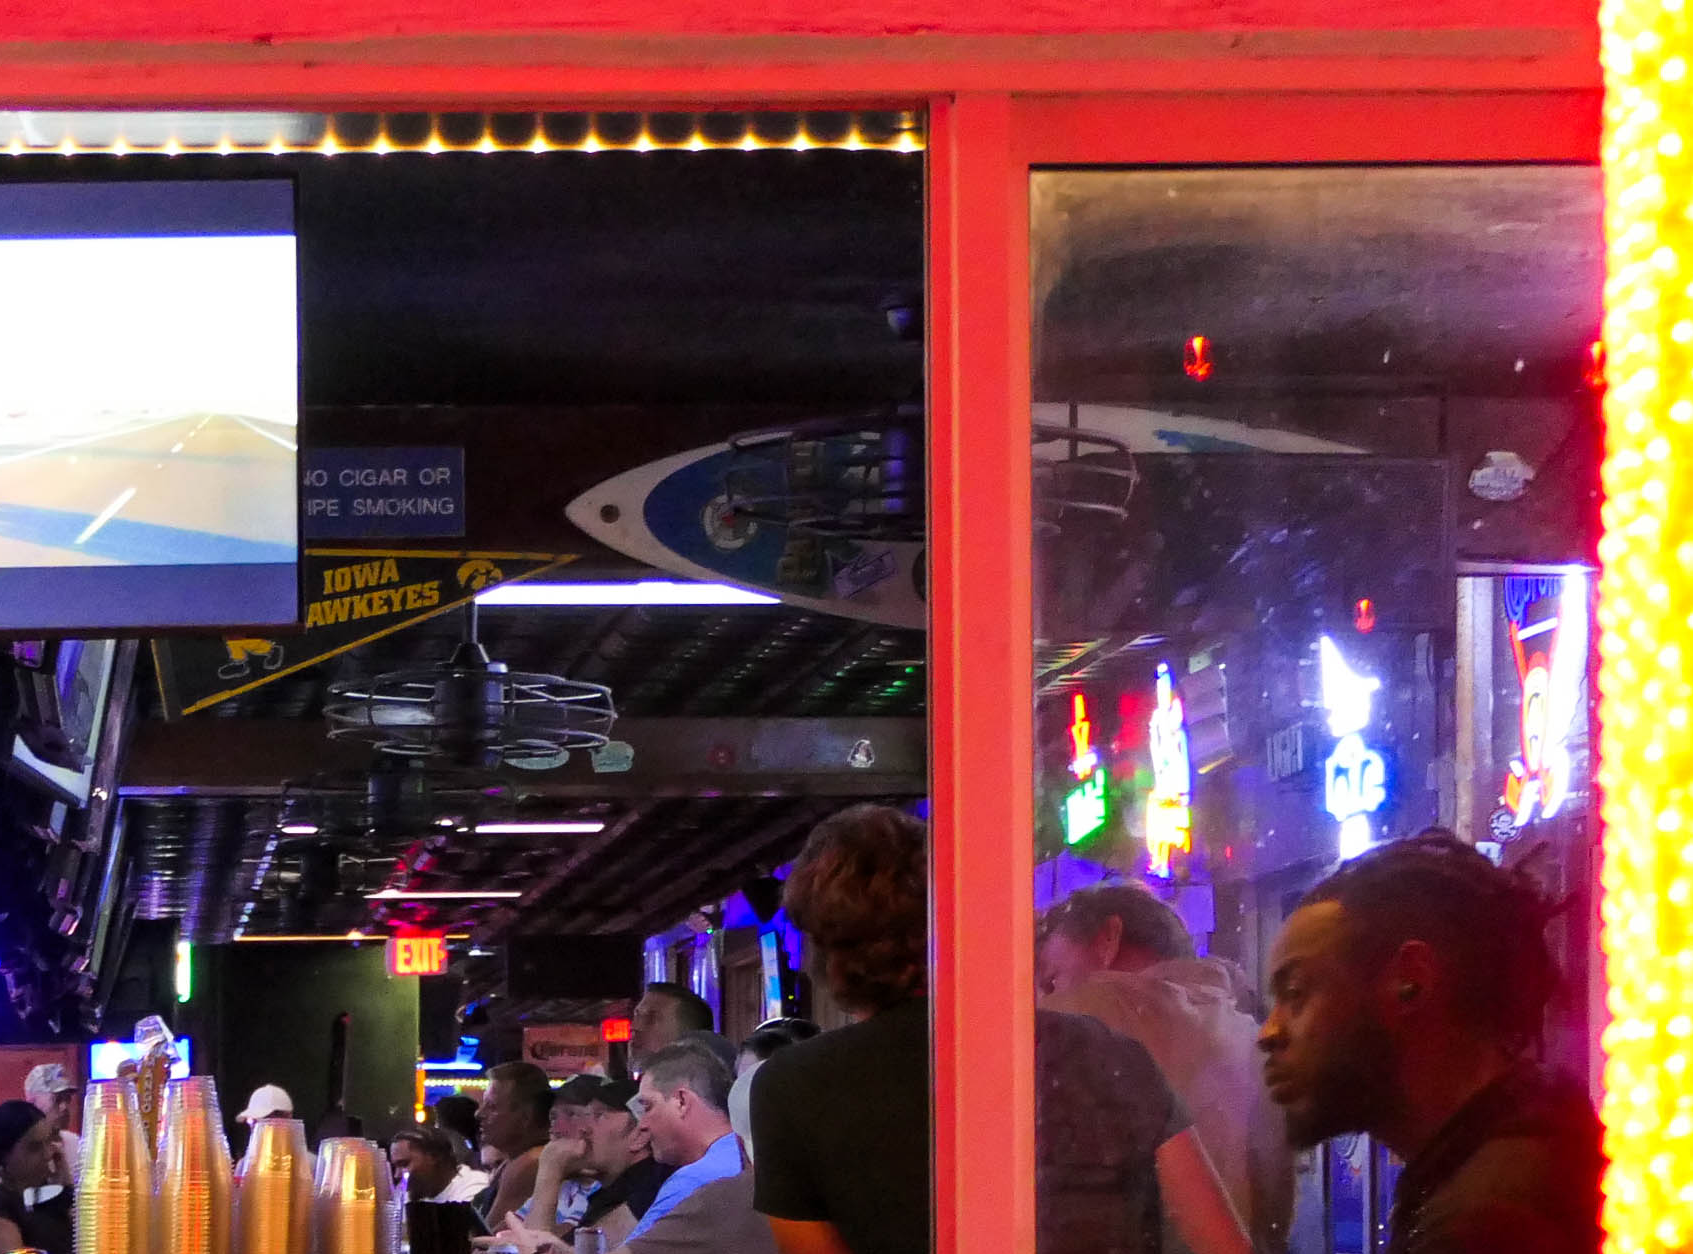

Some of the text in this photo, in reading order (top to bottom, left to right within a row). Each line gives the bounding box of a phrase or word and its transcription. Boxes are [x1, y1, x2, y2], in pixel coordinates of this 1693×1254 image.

[338, 467, 408, 486] CIGAR
[418, 466, 451, 485] OR
[307, 496, 455, 517] IPE SMOKING
[322, 558, 400, 596] IOWA
[305, 580, 440, 630] AWKEYES
[396, 937, 442, 974] EXIT
